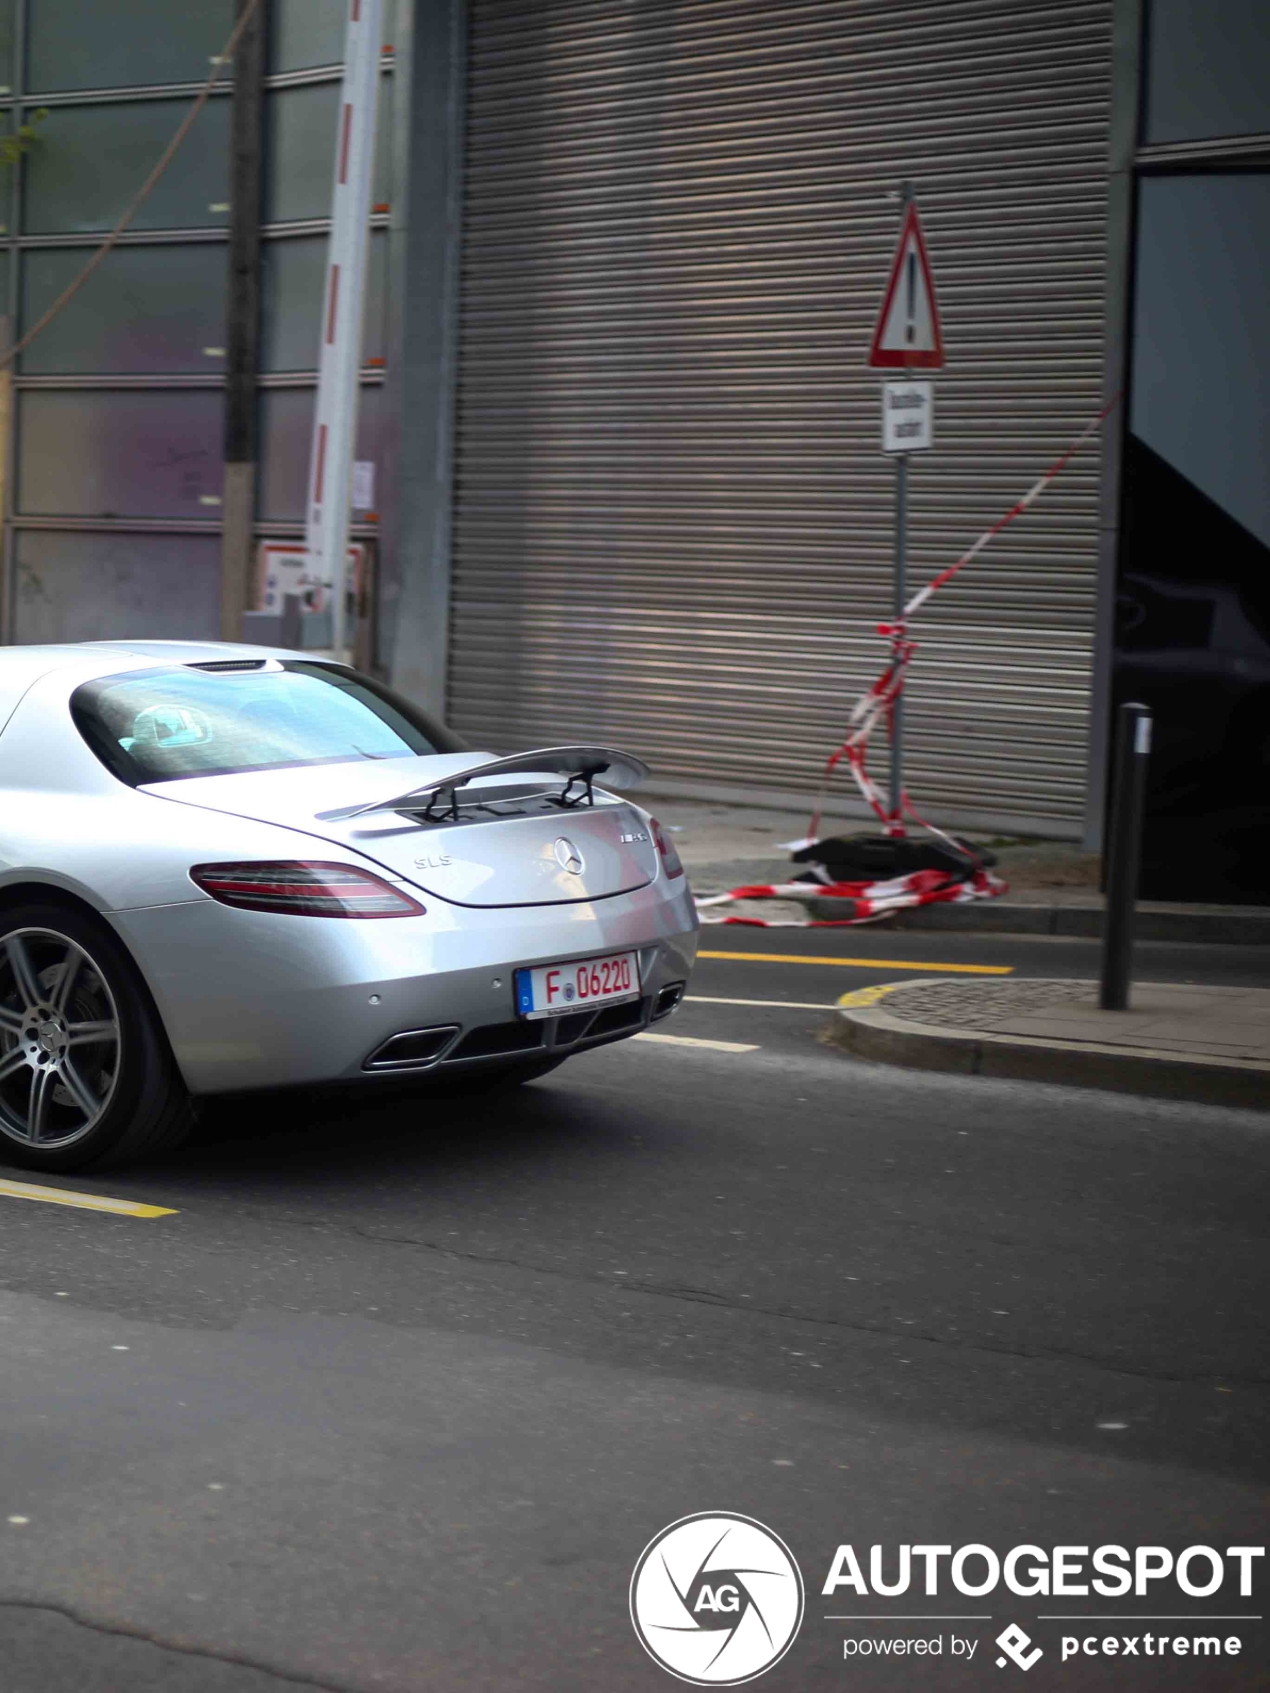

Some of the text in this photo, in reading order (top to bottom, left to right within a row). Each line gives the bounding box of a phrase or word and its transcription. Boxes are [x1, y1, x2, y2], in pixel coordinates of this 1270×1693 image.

[414, 855, 453, 869] SLS
[545, 958, 631, 1003] F 06220
